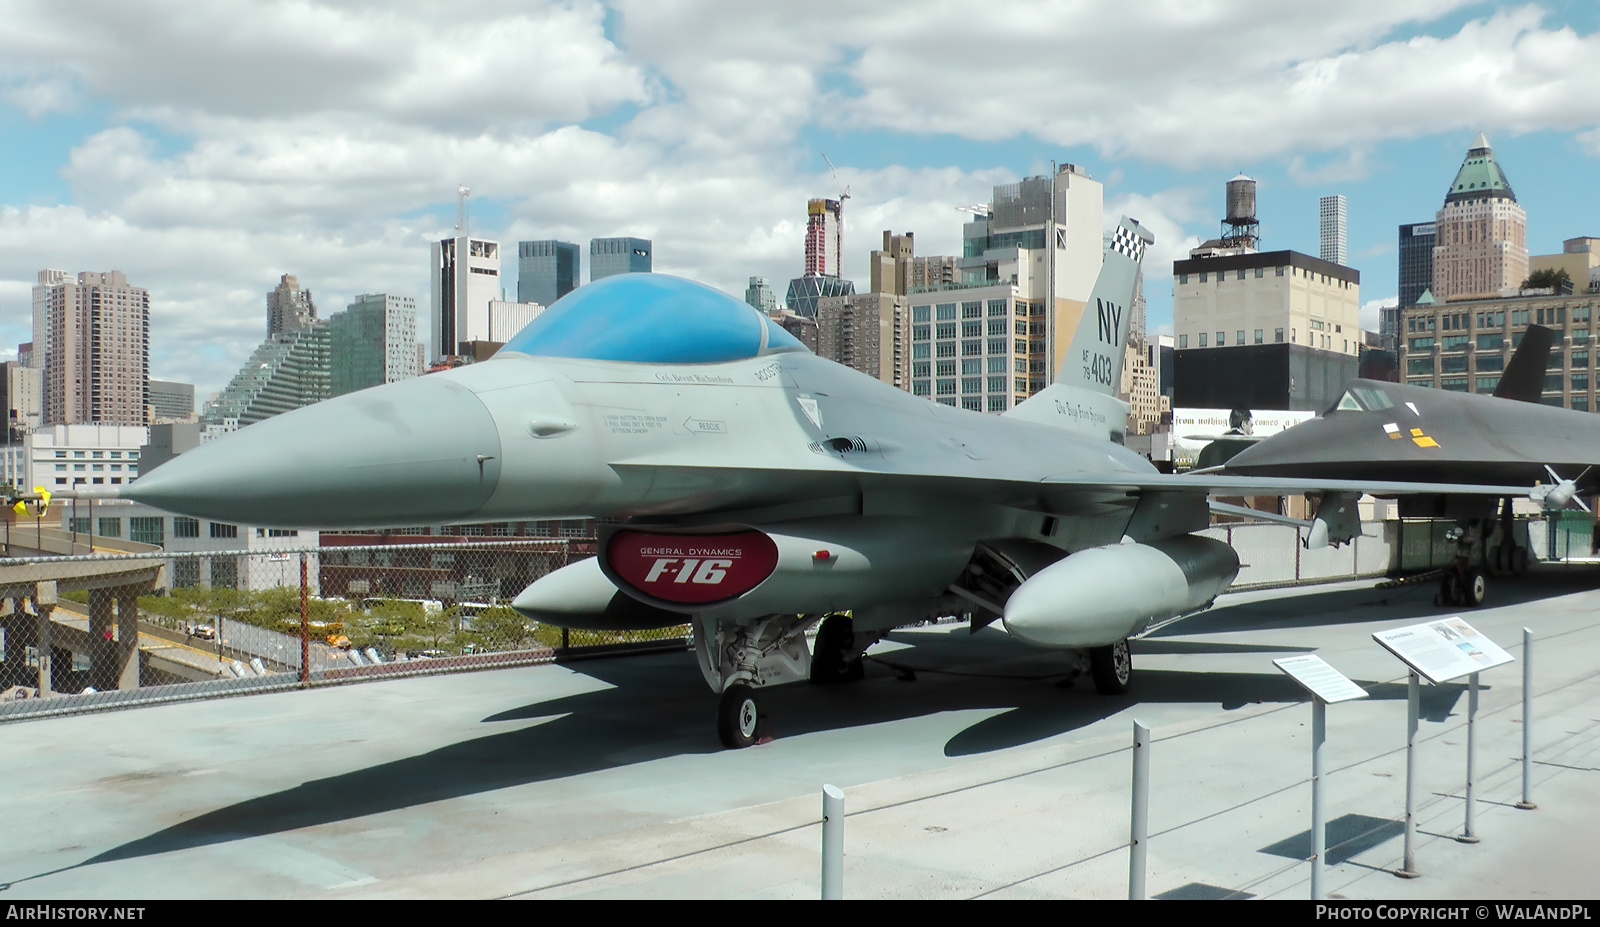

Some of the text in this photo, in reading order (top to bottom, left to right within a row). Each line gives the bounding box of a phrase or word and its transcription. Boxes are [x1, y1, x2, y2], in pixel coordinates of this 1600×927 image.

[1096, 297, 1122, 347] NY
[1082, 349, 1089, 362] AF
[1083, 365, 1090, 380] 79
[1091, 352, 1112, 386] 403
[698, 422, 720, 431] RESCUE
[1175, 416, 1195, 427] from
[1198, 416, 1228, 427] nothing
[1254, 418, 1279, 426] comes
[1284, 419, 1290, 427] a
[640, 547, 742, 556] GENERAL DYNAMICS
[644, 558, 733, 584] F-16
